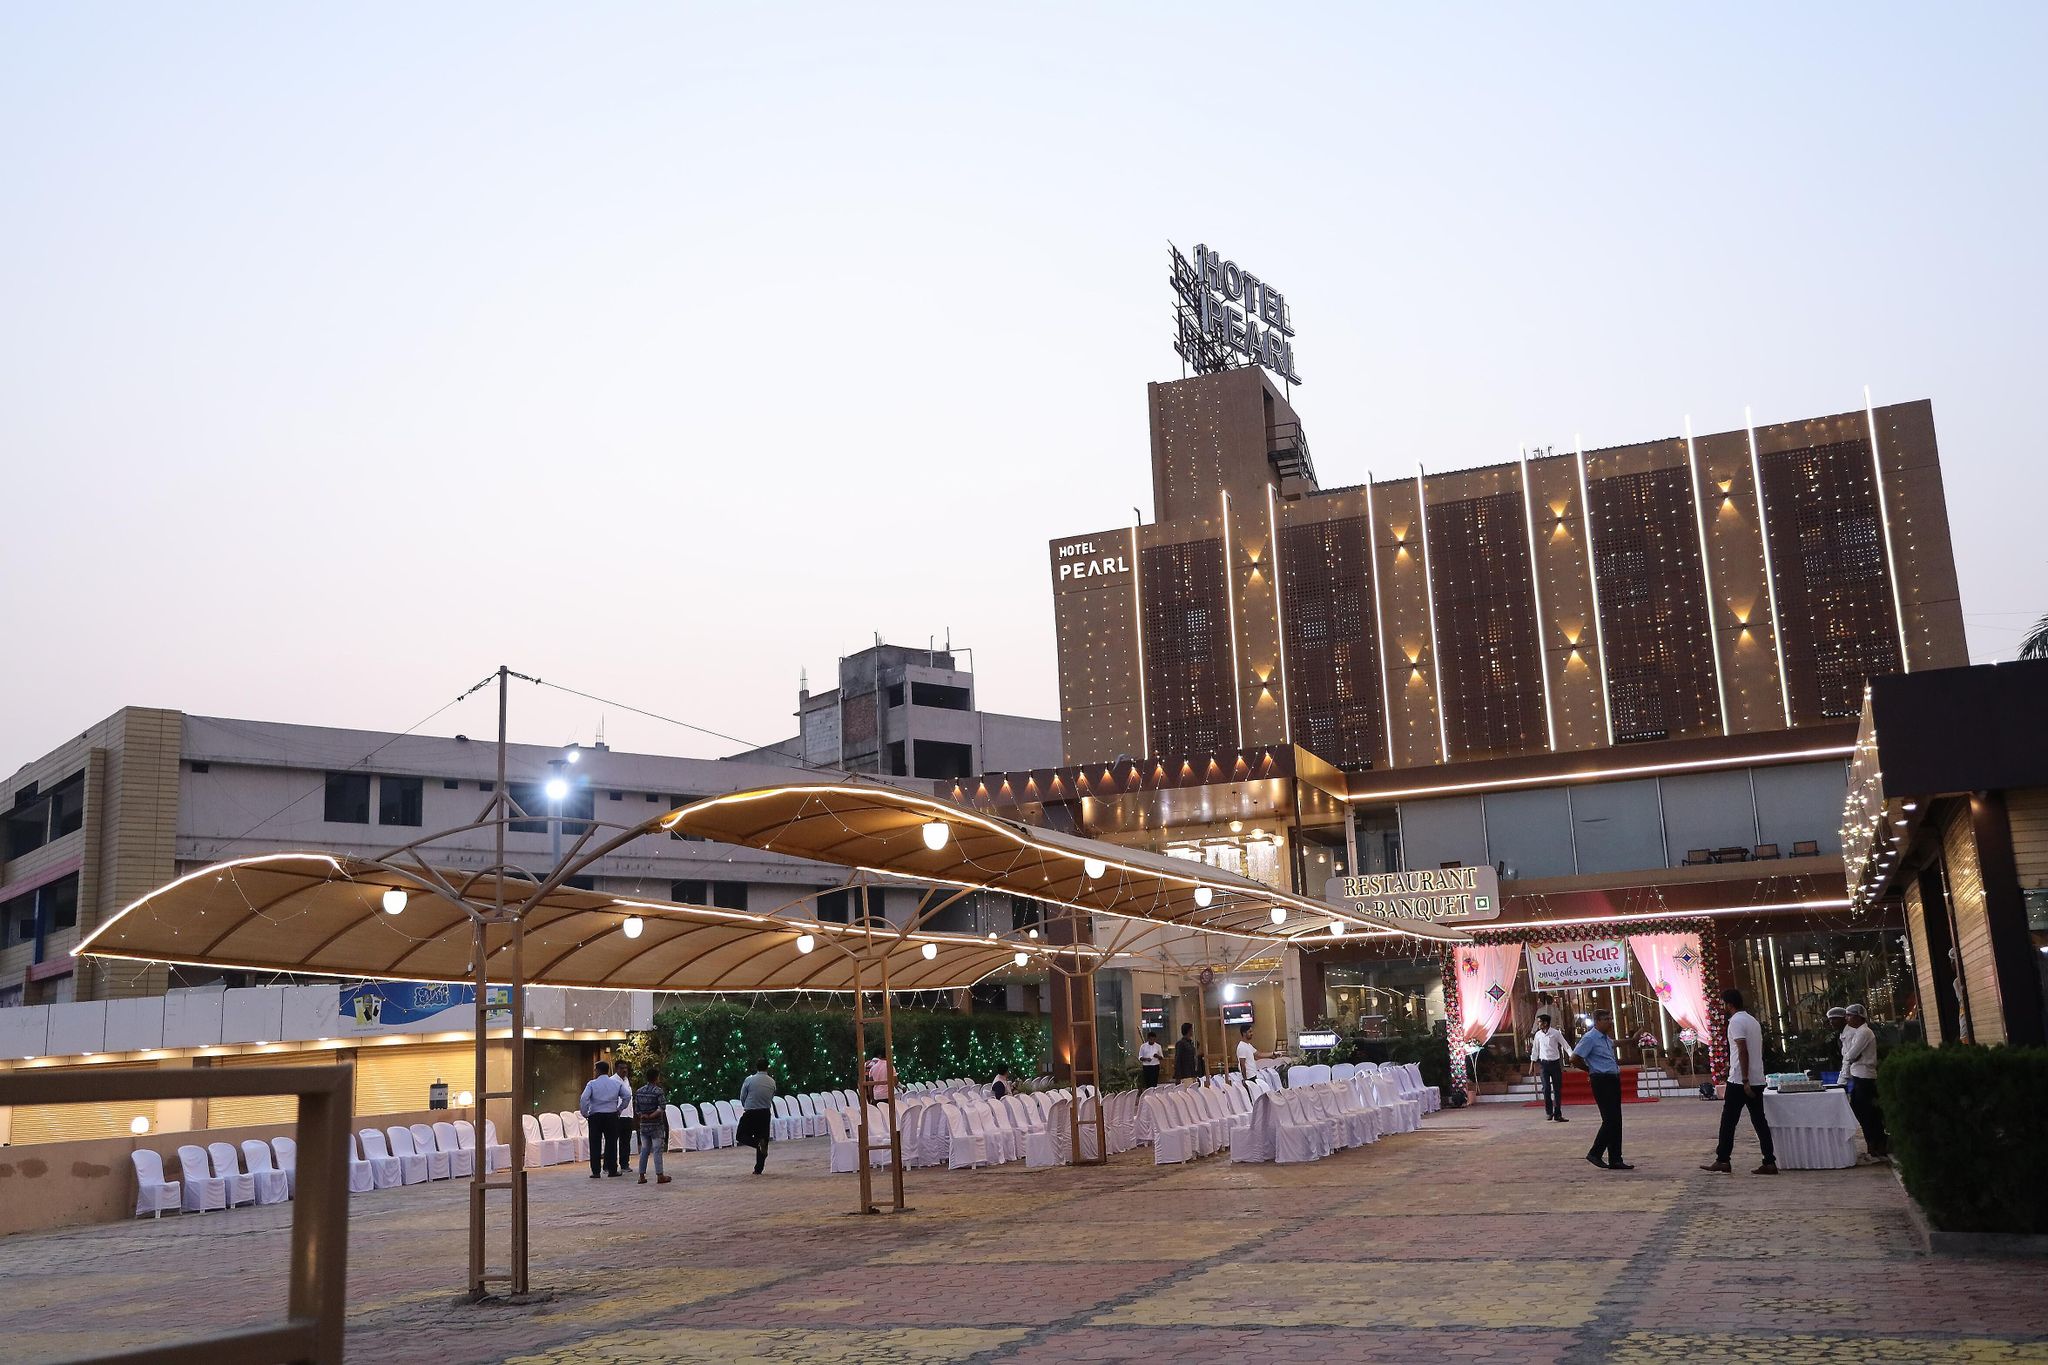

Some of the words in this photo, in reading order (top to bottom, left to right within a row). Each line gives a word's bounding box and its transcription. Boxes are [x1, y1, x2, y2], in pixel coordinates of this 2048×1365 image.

[1196, 243, 1295, 337] HOTEL
[1201, 292, 1302, 386] PEARL
[1059, 542, 1096, 557] HOTEL
[1060, 556, 1129, 581] PEARL
[1343, 867, 1478, 898] RESTAURANT
[1373, 894, 1470, 922] BANQUET
[1536, 946, 1569, 965] પટેલ
[1572, 943, 1619, 962] પરિવાર
